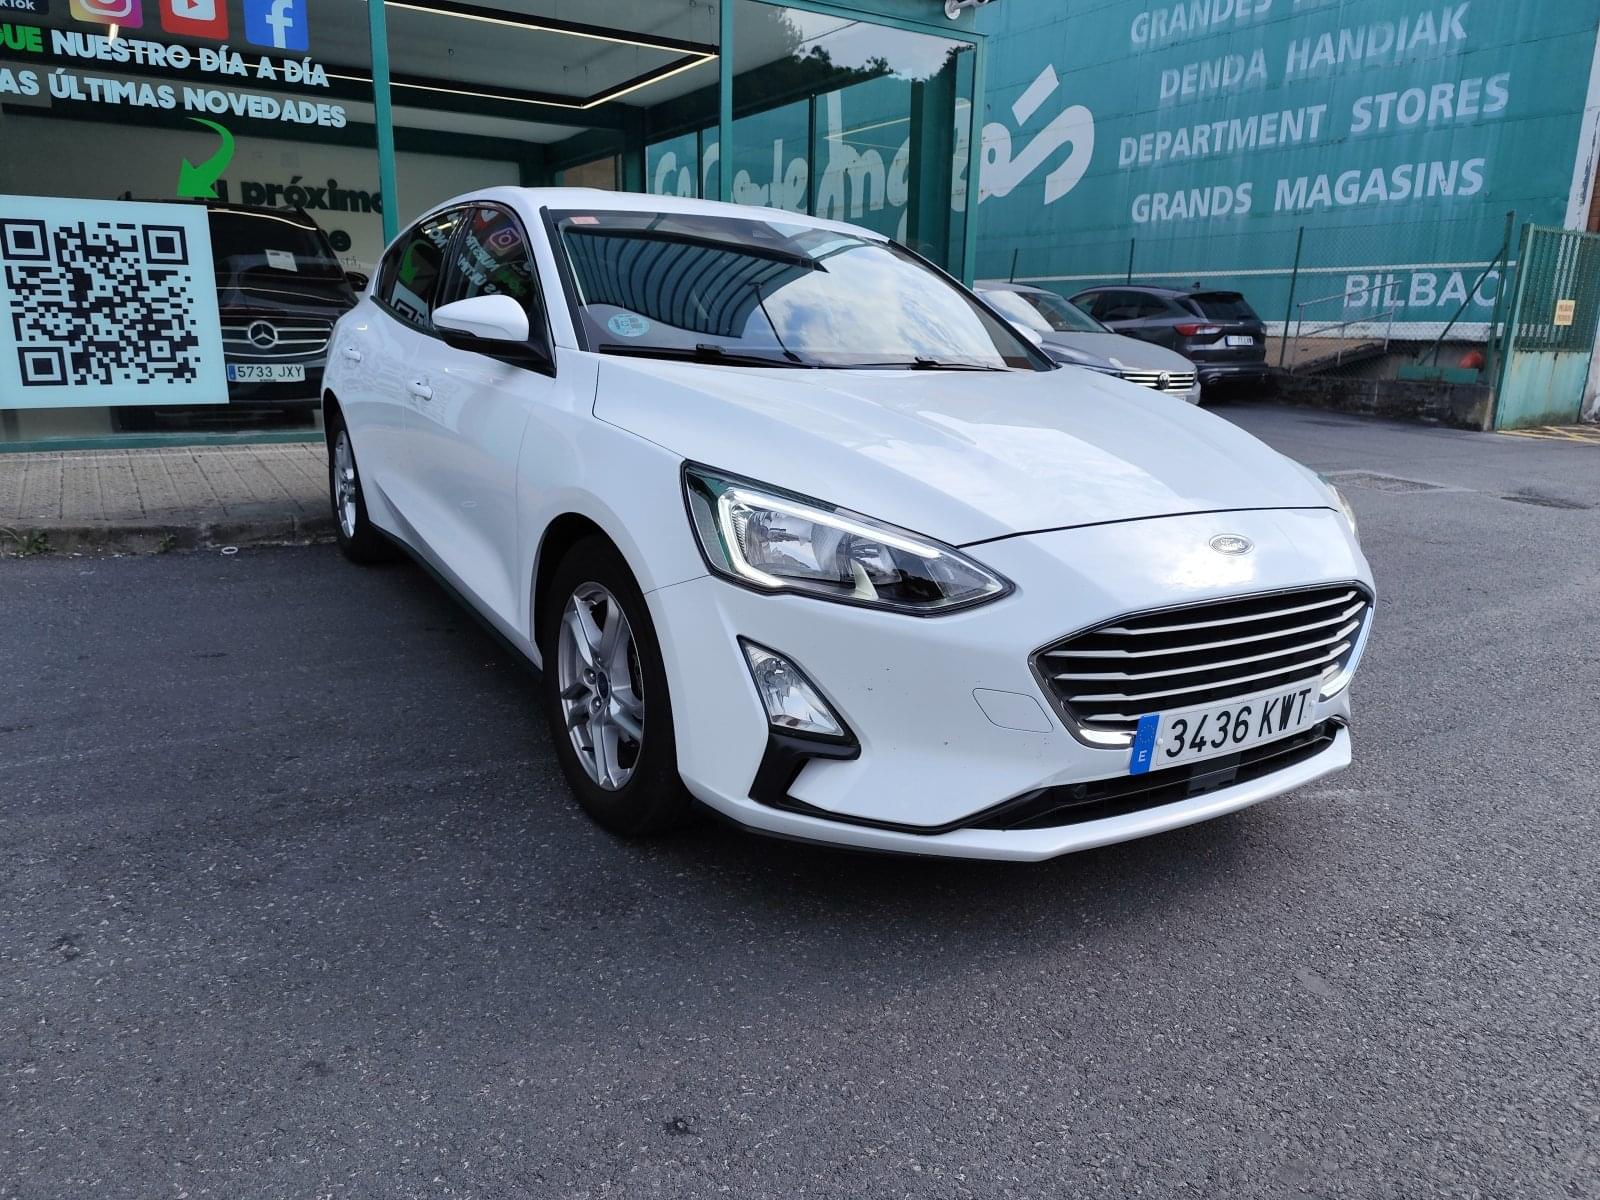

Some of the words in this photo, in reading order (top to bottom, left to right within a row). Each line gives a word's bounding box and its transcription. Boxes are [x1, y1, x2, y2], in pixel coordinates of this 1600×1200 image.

[0, 23, 43, 53] UE
[51, 29, 191, 69] NUESTRO
[199, 44, 248, 76] DÍA
[256, 57, 277, 80] A
[284, 57, 330, 87] DÍA
[1160, 47, 1268, 100] DENDA
[1285, 1, 1471, 74] HANDIAK
[48, 67, 176, 109] ÚLTIMAS
[183, 87, 346, 128] NOVEDADES
[1119, 103, 1327, 169] DEPARTMENT
[1350, 71, 1510, 133] STORES
[1131, 181, 1253, 224] GRANDS
[1274, 157, 1486, 211] MAGASINS
[1343, 270, 1507, 308] BILBAO
[237, 366, 273, 378] 5733
[278, 366, 302, 378] JXY
[1138, 750, 1147, 762] E
[1166, 706, 1252, 758] 3436
[1258, 688, 1312, 738] KWT
